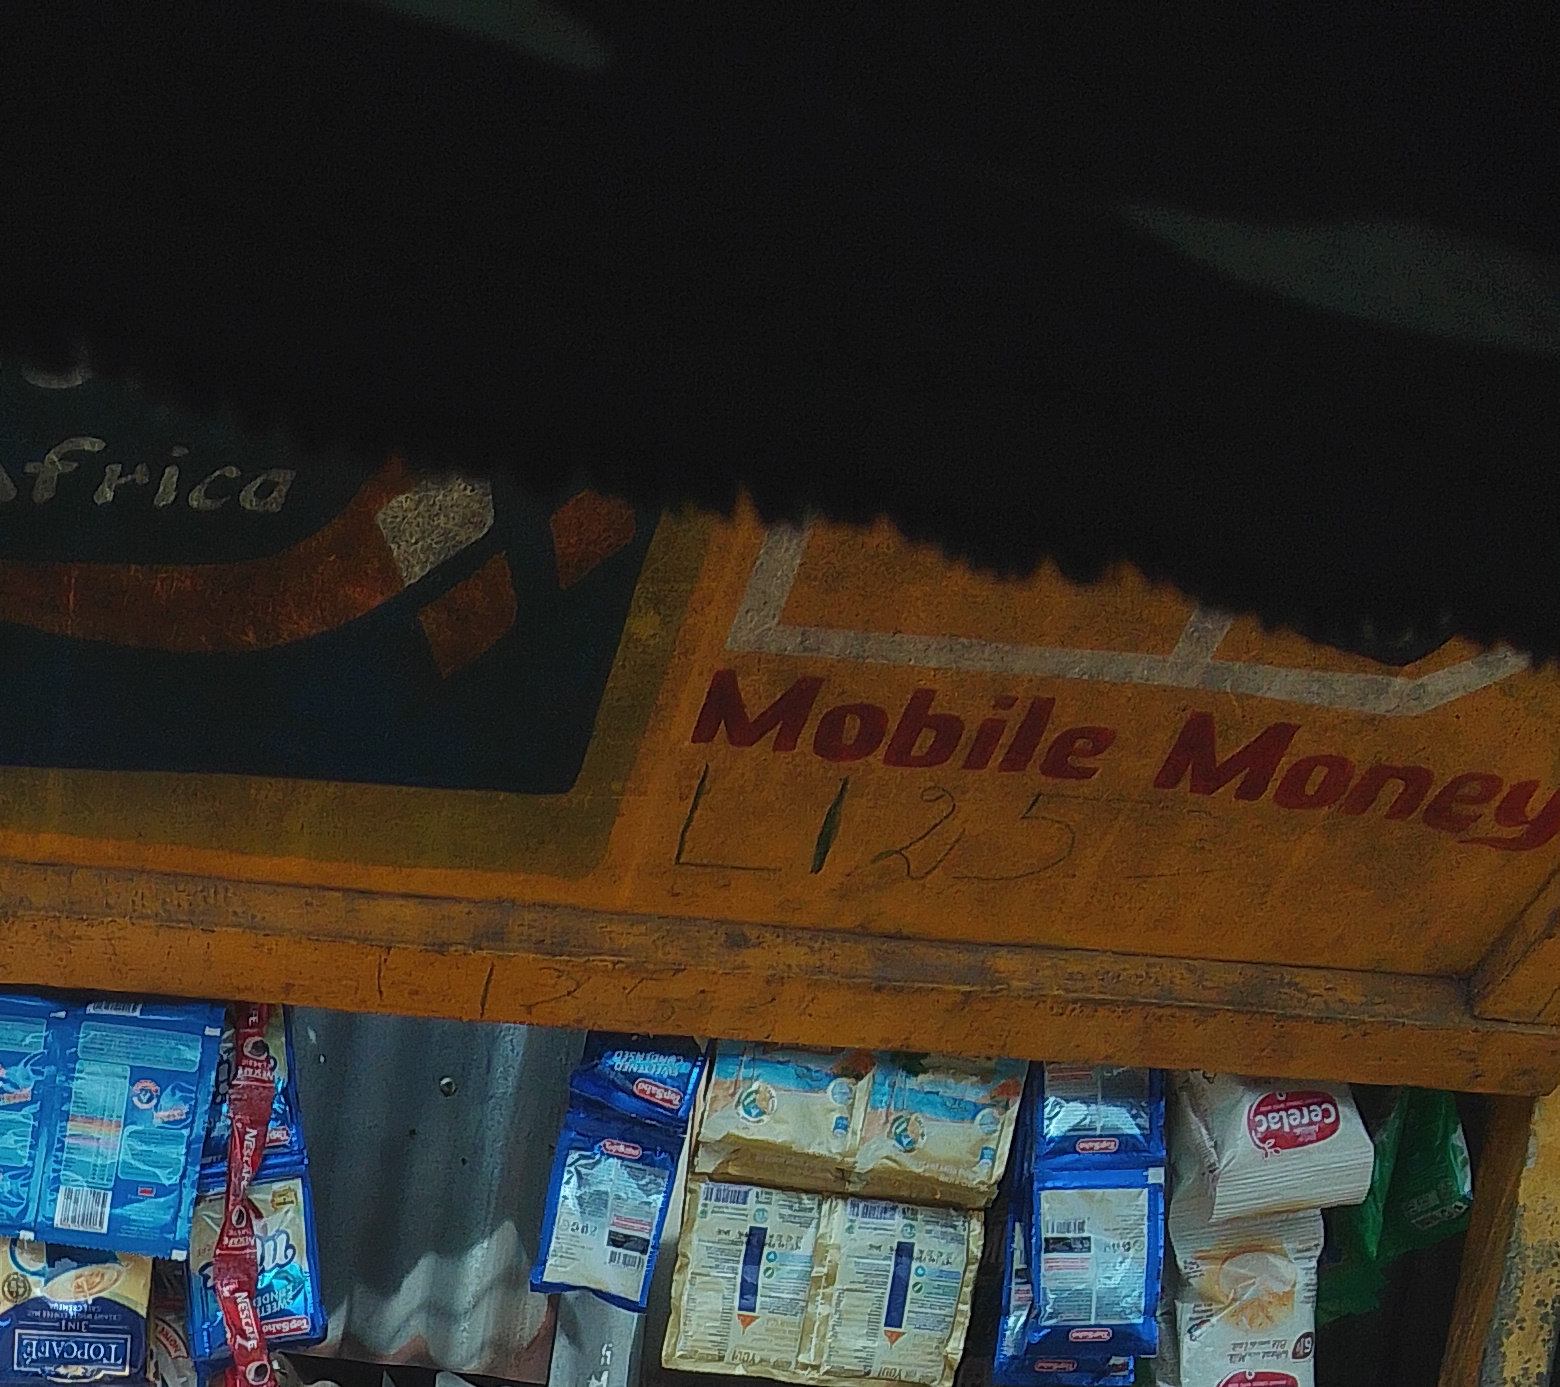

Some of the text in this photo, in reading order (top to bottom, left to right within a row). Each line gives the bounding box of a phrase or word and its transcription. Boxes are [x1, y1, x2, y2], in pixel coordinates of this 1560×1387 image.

[689, 669, 1560, 852] Mobile Money
[636, 1081, 681, 1106] TopSaho
[1253, 1101, 1336, 1134] Cerelac
[233, 1290, 260, 1353] NESCAFE
[22, 1339, 123, 1365] TOPCAFÉ
